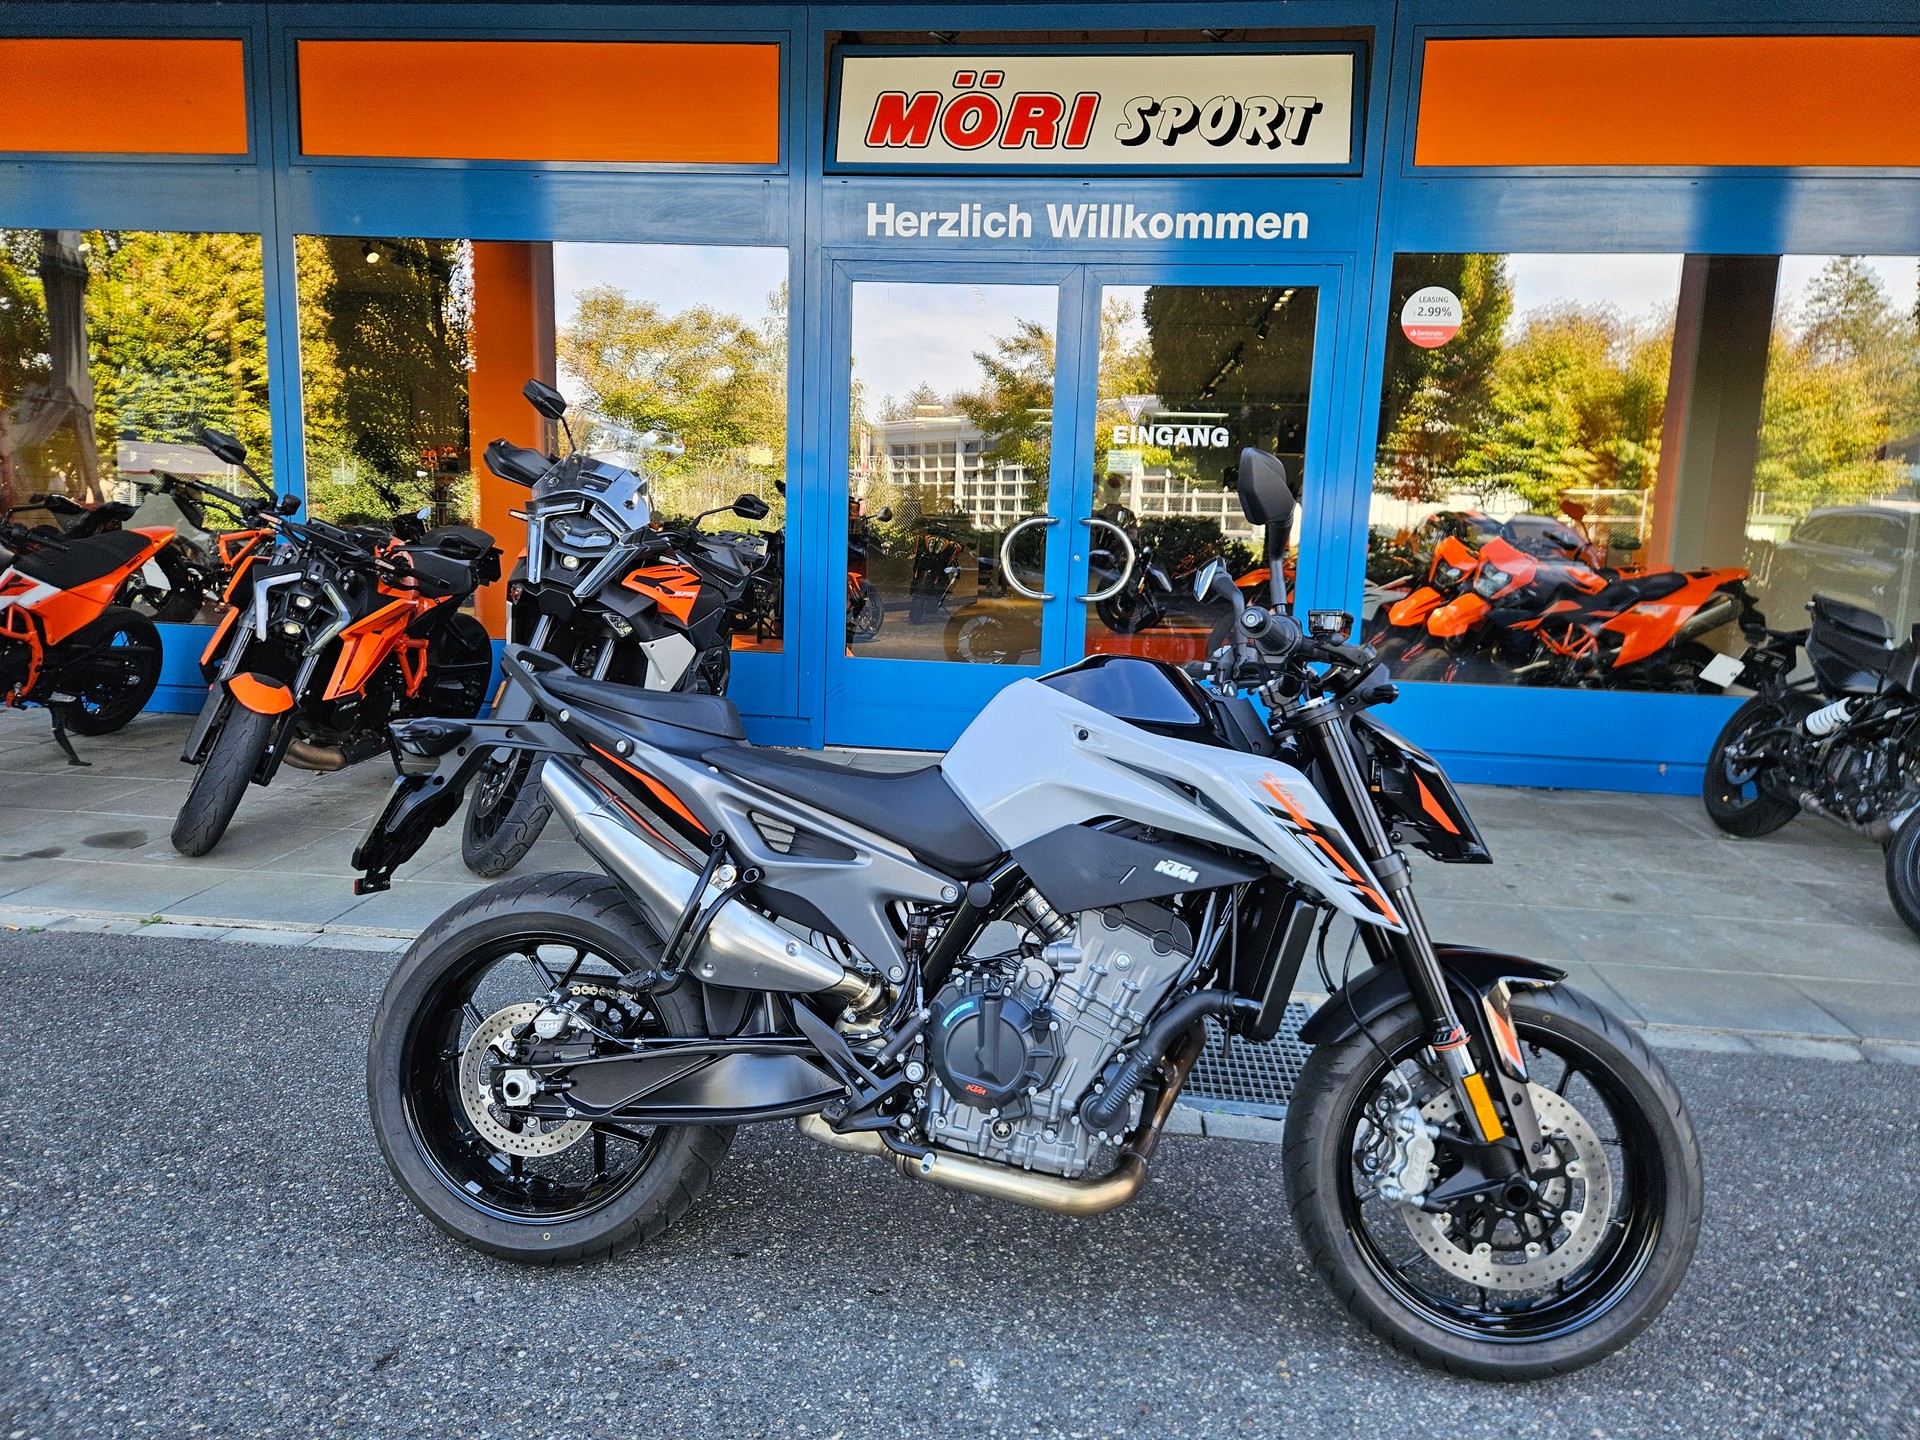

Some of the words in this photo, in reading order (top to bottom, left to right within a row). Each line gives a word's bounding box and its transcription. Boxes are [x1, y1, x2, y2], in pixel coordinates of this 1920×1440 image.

[864, 70, 1101, 150] MÖRI
[1114, 95, 1323, 149] SPORT
[867, 203, 1032, 239] Herzlich
[1047, 204, 1309, 240] Willkommen
[1417, 306, 1452, 317] 2.99%
[1113, 426, 1229, 447] EINGANG
[1154, 860, 1199, 883] KTM
[965, 1084, 986, 1095] KTM
